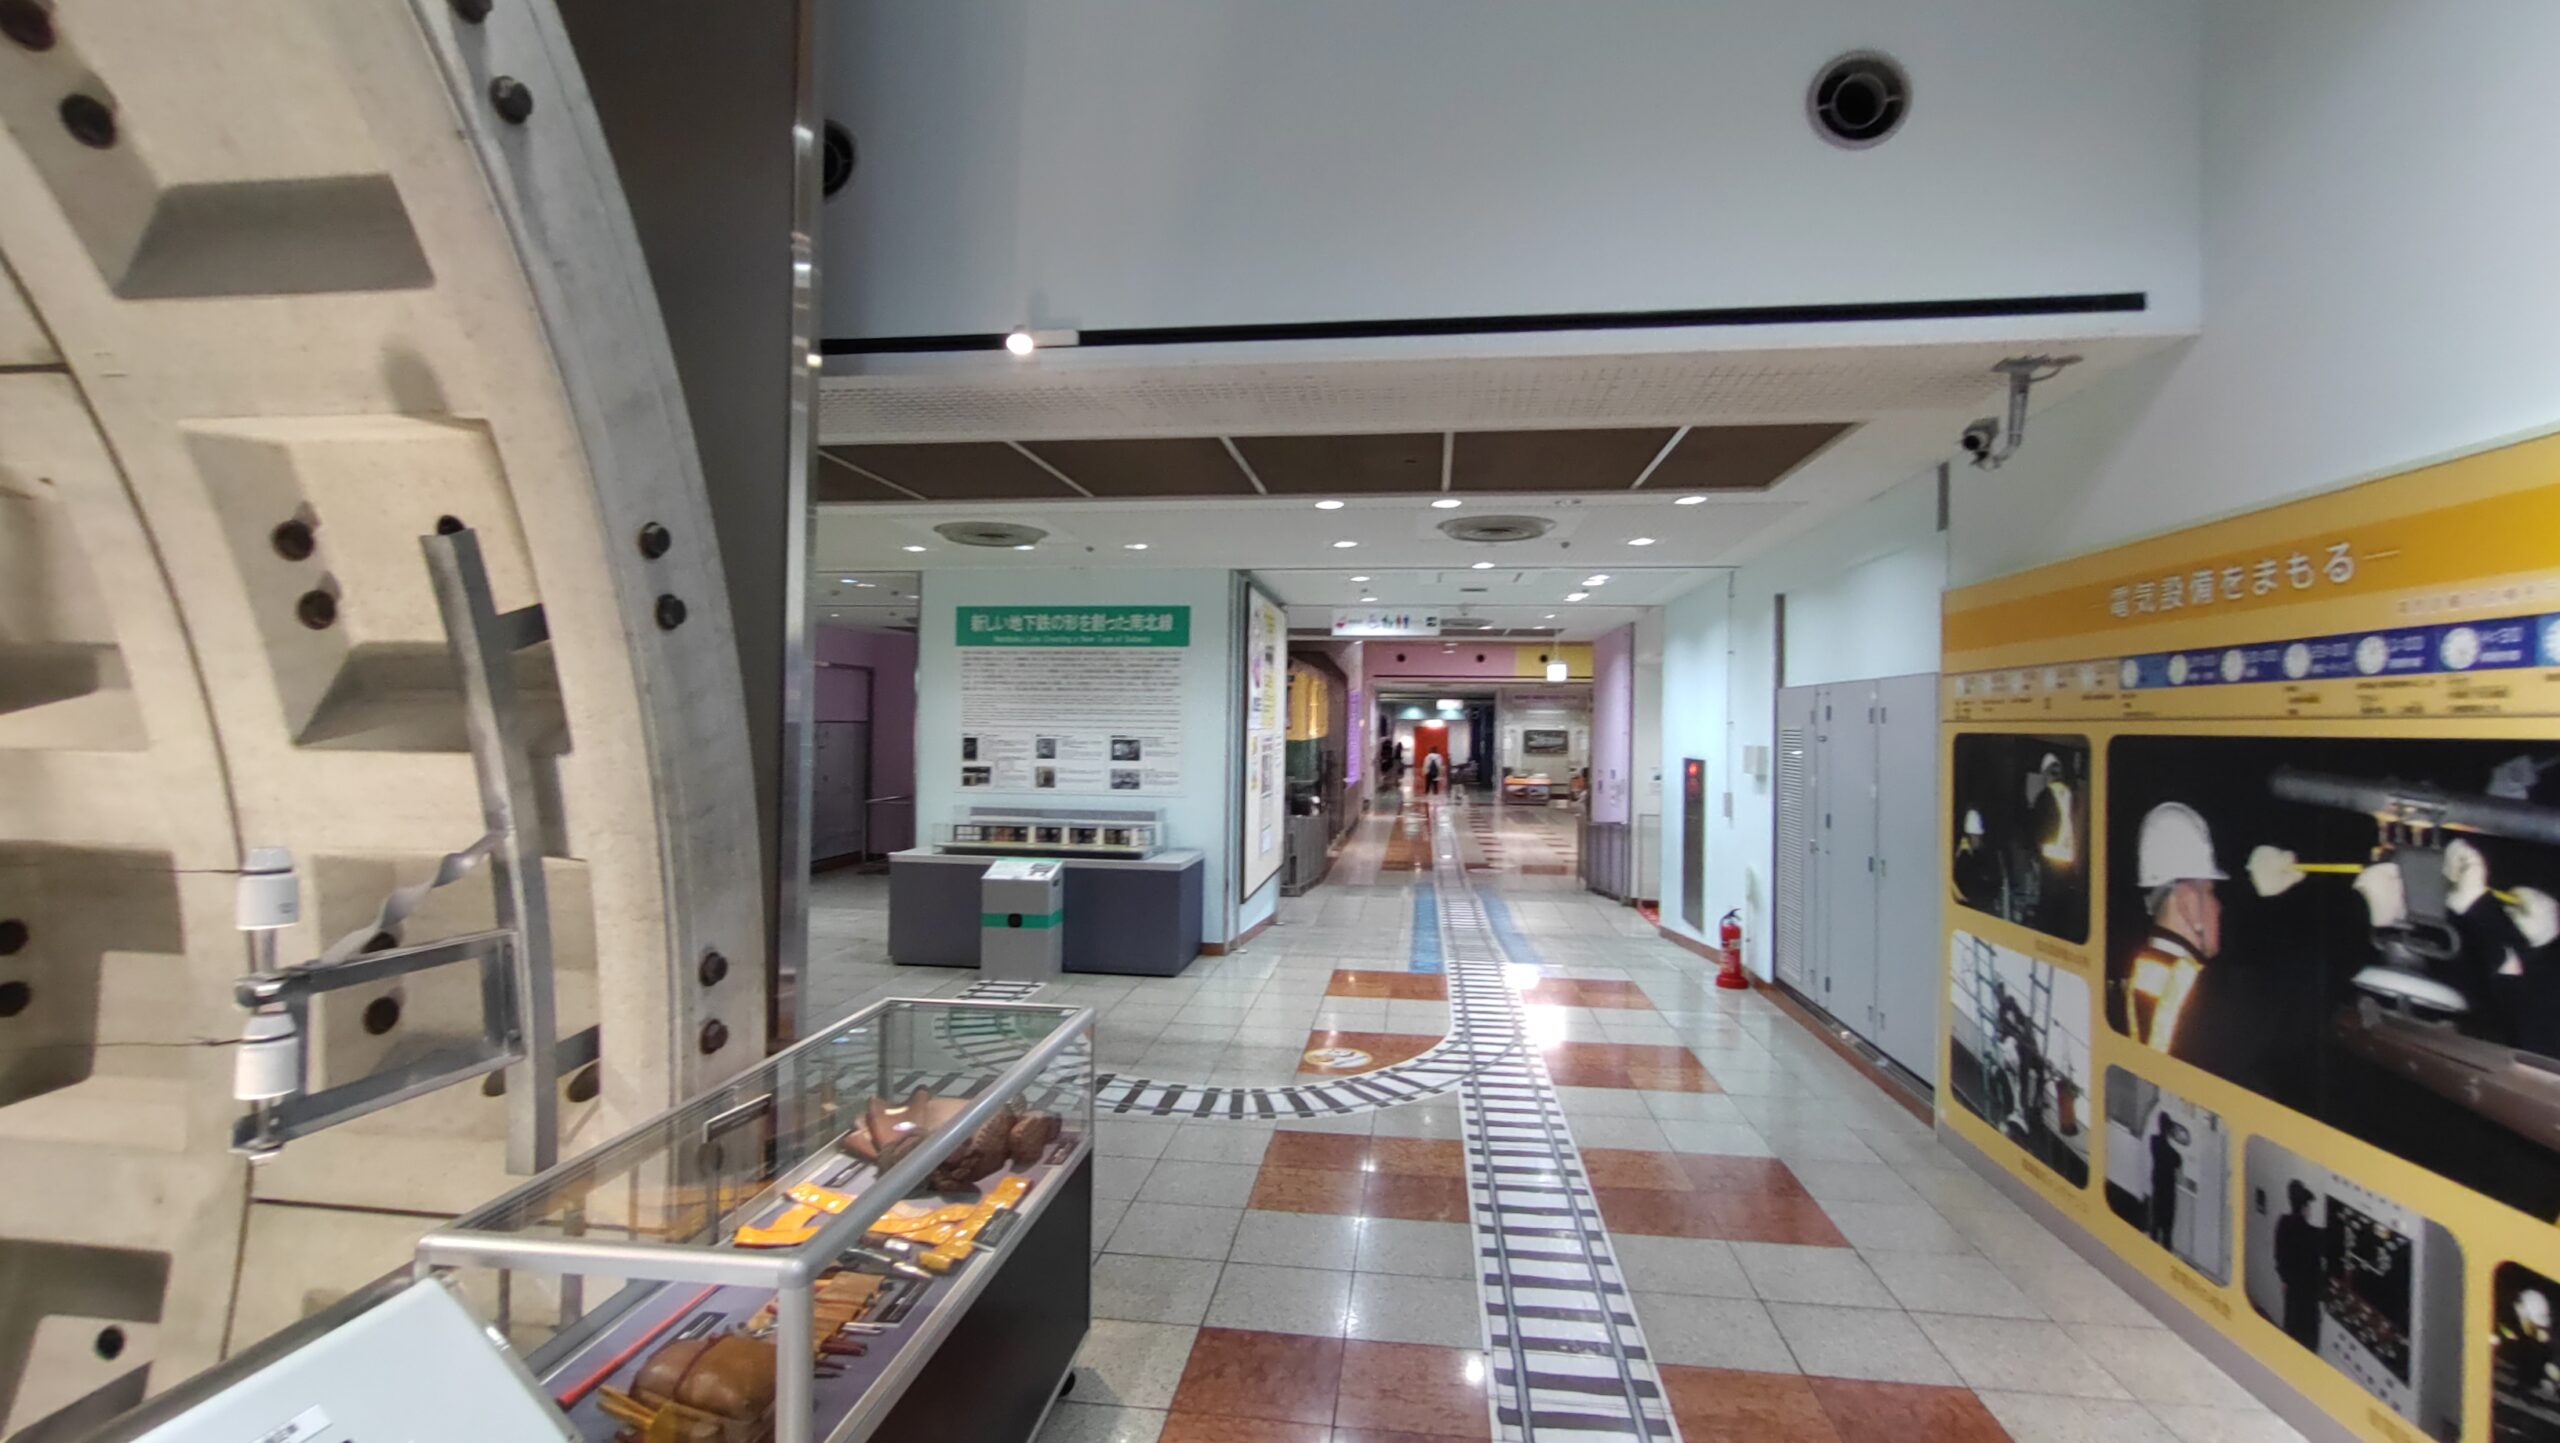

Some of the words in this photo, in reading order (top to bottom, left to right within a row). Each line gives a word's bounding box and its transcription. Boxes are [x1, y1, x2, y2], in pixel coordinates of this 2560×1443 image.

[2109, 541, 2355, 618] 電気設備をまもる
